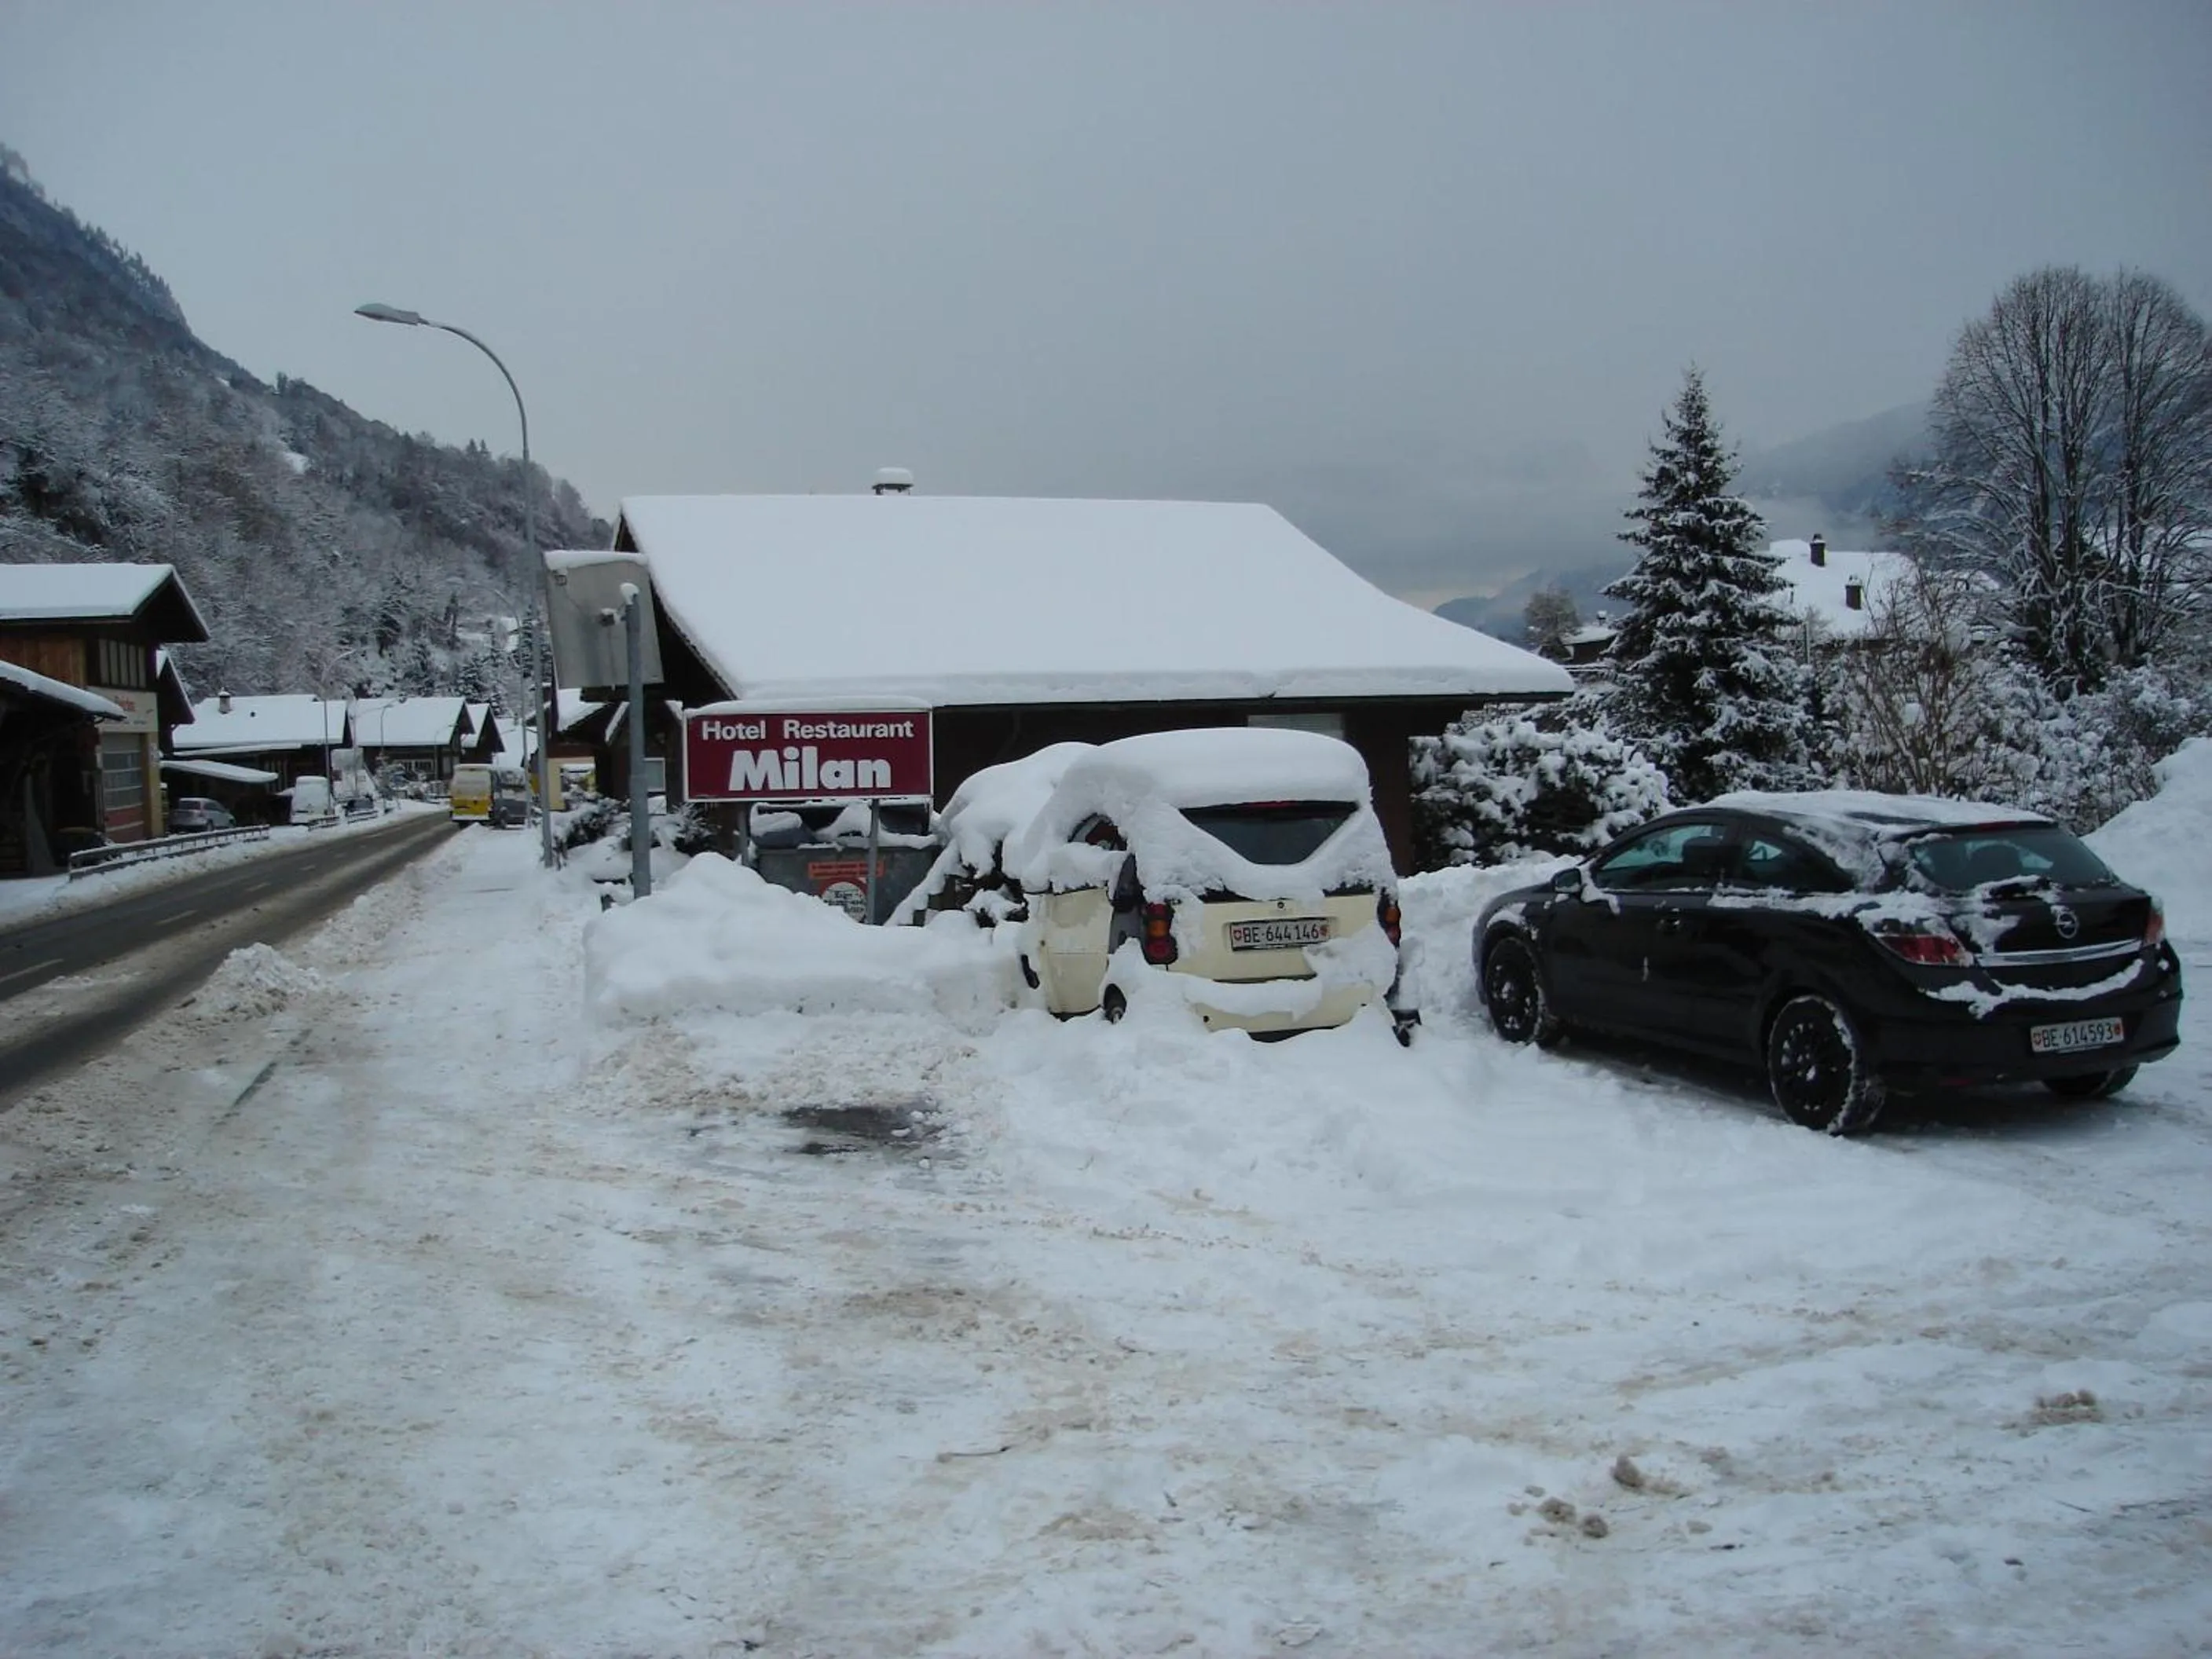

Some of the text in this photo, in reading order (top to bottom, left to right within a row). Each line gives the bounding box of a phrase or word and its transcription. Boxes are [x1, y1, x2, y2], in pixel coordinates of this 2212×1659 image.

[701, 719, 914, 741] Hotel Restaurant
[727, 745, 892, 792] Milan
